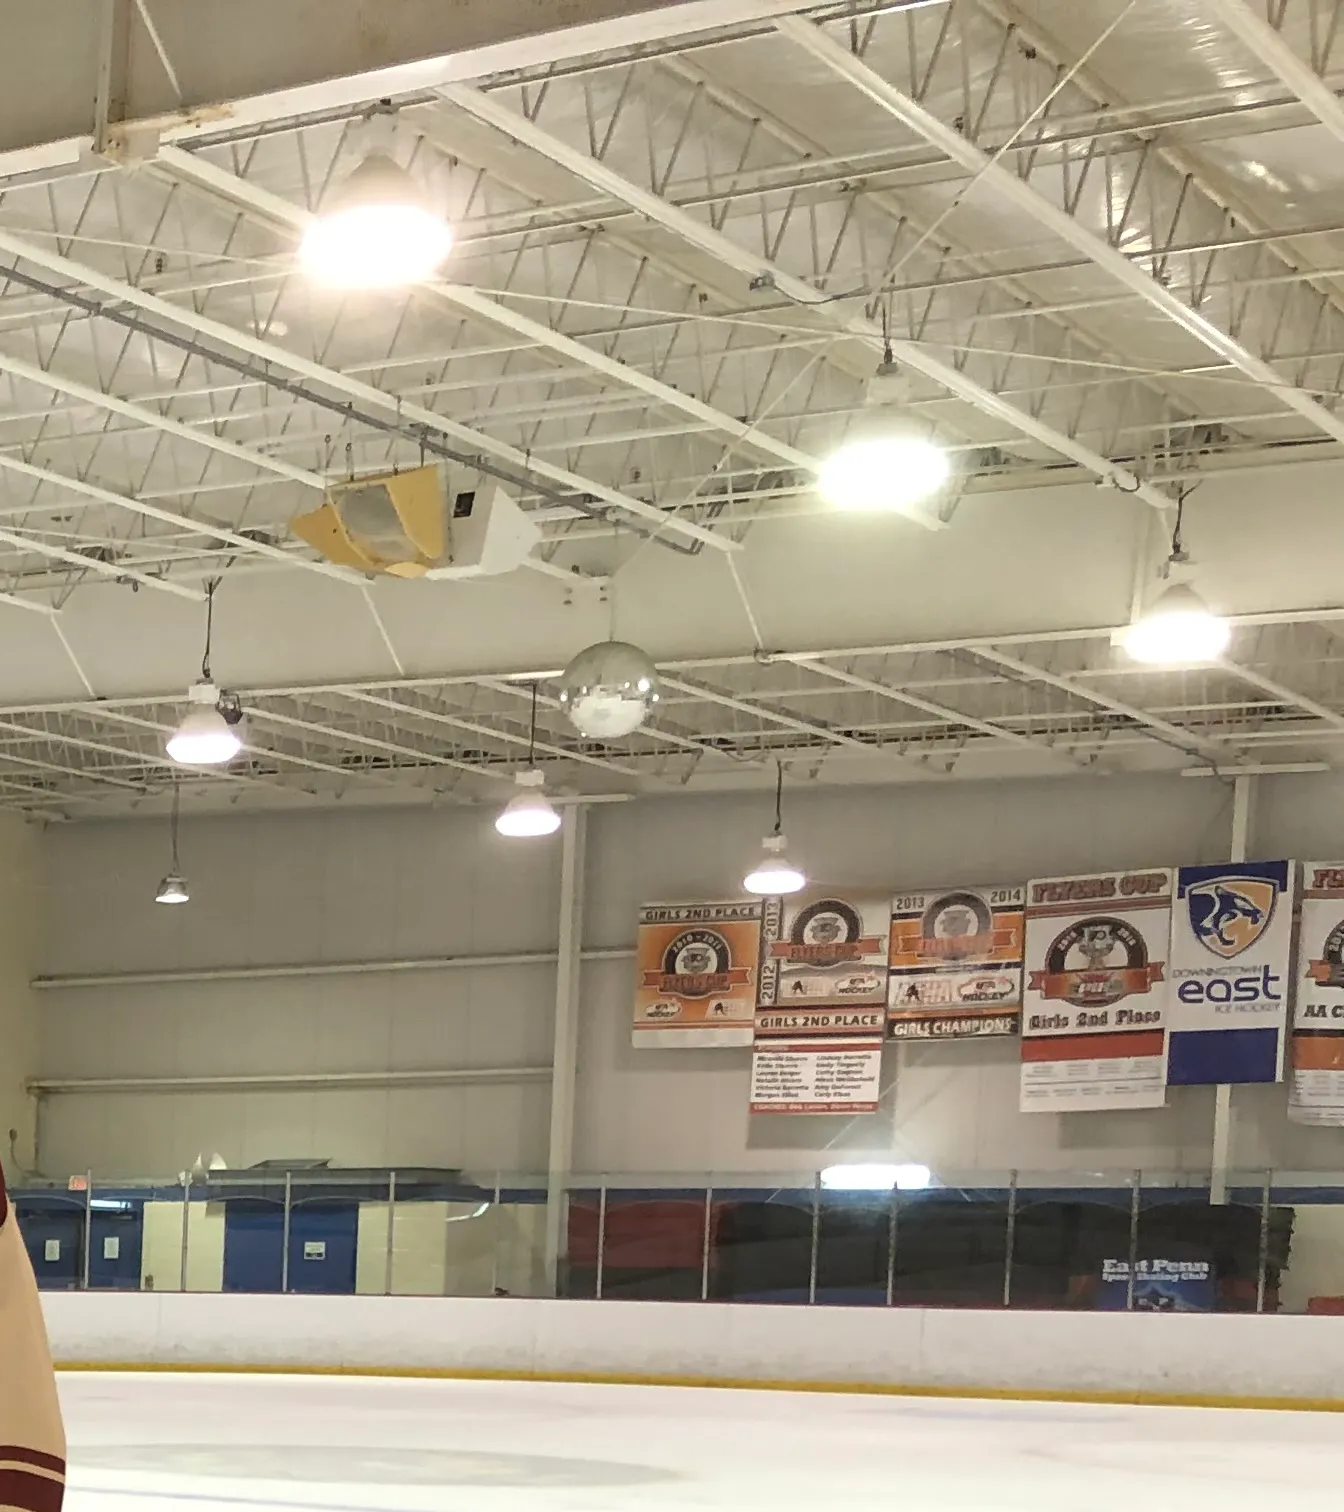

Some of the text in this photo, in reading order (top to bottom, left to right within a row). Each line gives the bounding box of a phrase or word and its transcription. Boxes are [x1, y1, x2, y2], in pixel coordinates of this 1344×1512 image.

[991, 889, 1021, 902] 2014
[897, 897, 925, 910] 2013
[645, 907, 755, 920] GIRLS 2ND PLACE
[761, 902, 778, 1000] 2012 2013
[1178, 964, 1281, 1003] east
[760, 1015, 878, 1027] GIRLS 2ND PLACE
[1076, 1011, 1108, 1027] 2nd
[1115, 1010, 1161, 1025] Place
[894, 1018, 1011, 1036] GIRLS CHAMPIONS
[1102, 1258, 1149, 1273] Eat
